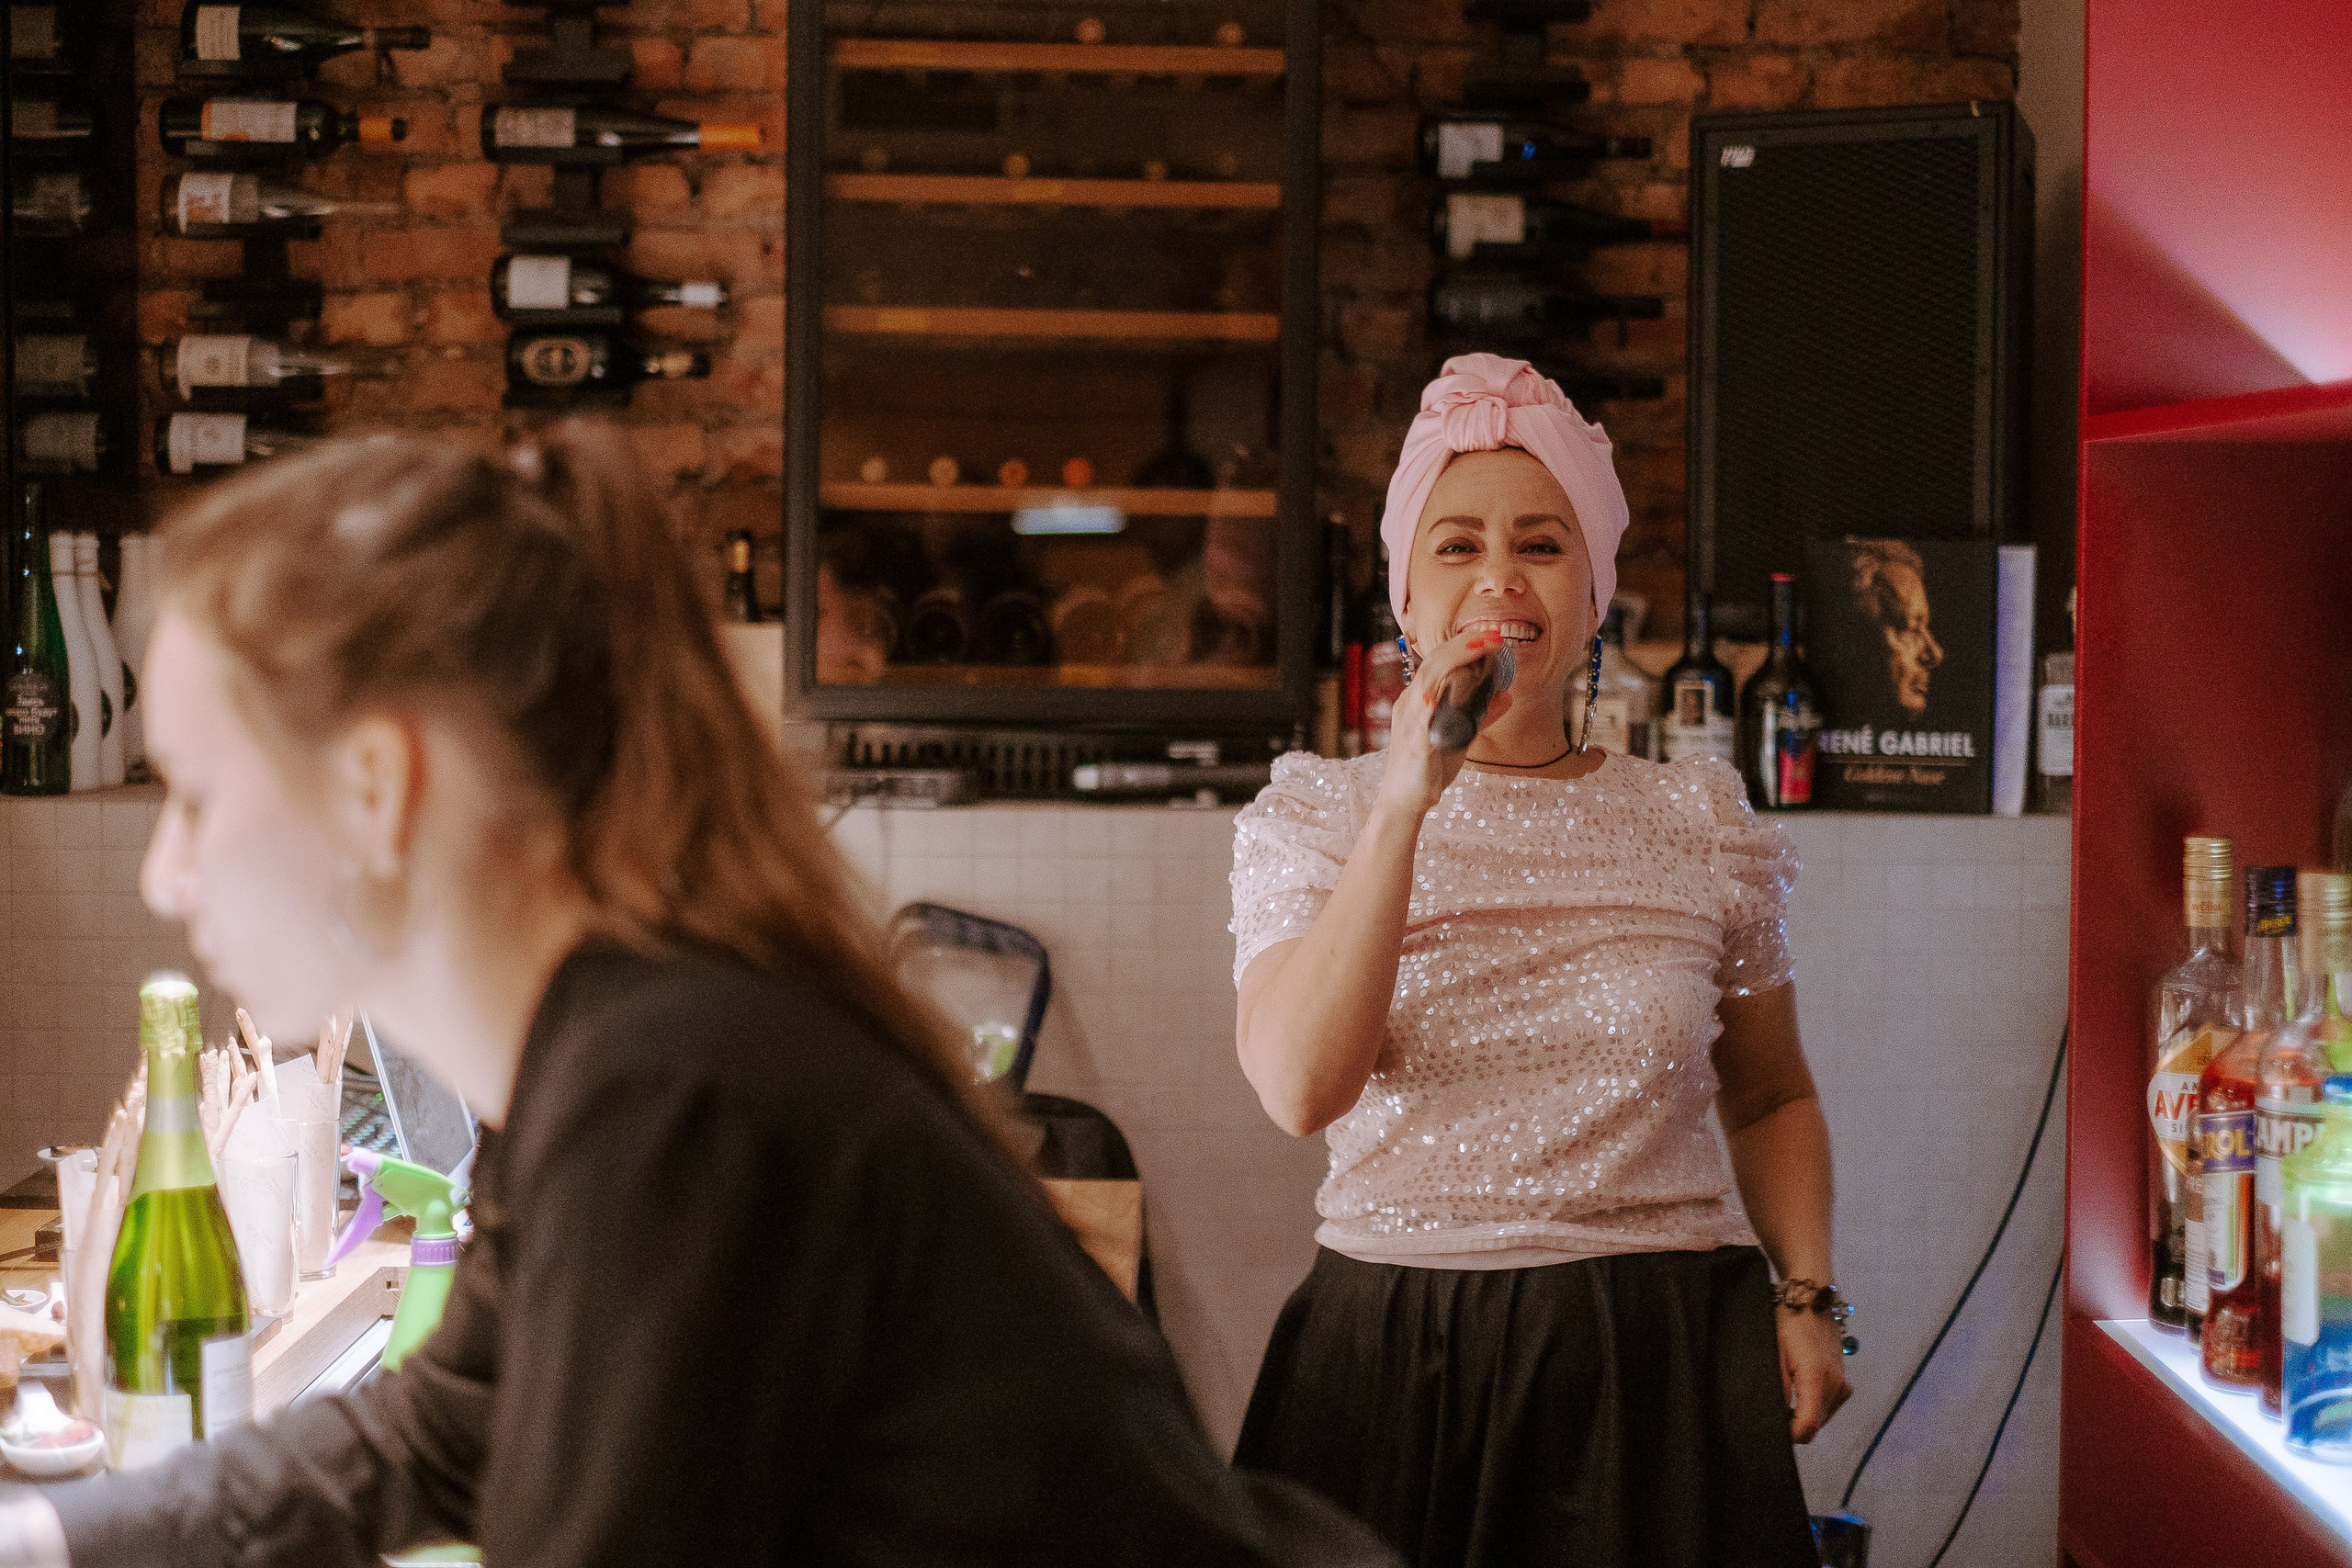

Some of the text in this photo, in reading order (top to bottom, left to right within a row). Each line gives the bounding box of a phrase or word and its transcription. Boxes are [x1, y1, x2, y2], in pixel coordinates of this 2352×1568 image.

[13, 723, 45, 736] ВИНО
[1819, 725, 1975, 758] RENÉ GABRIEL
